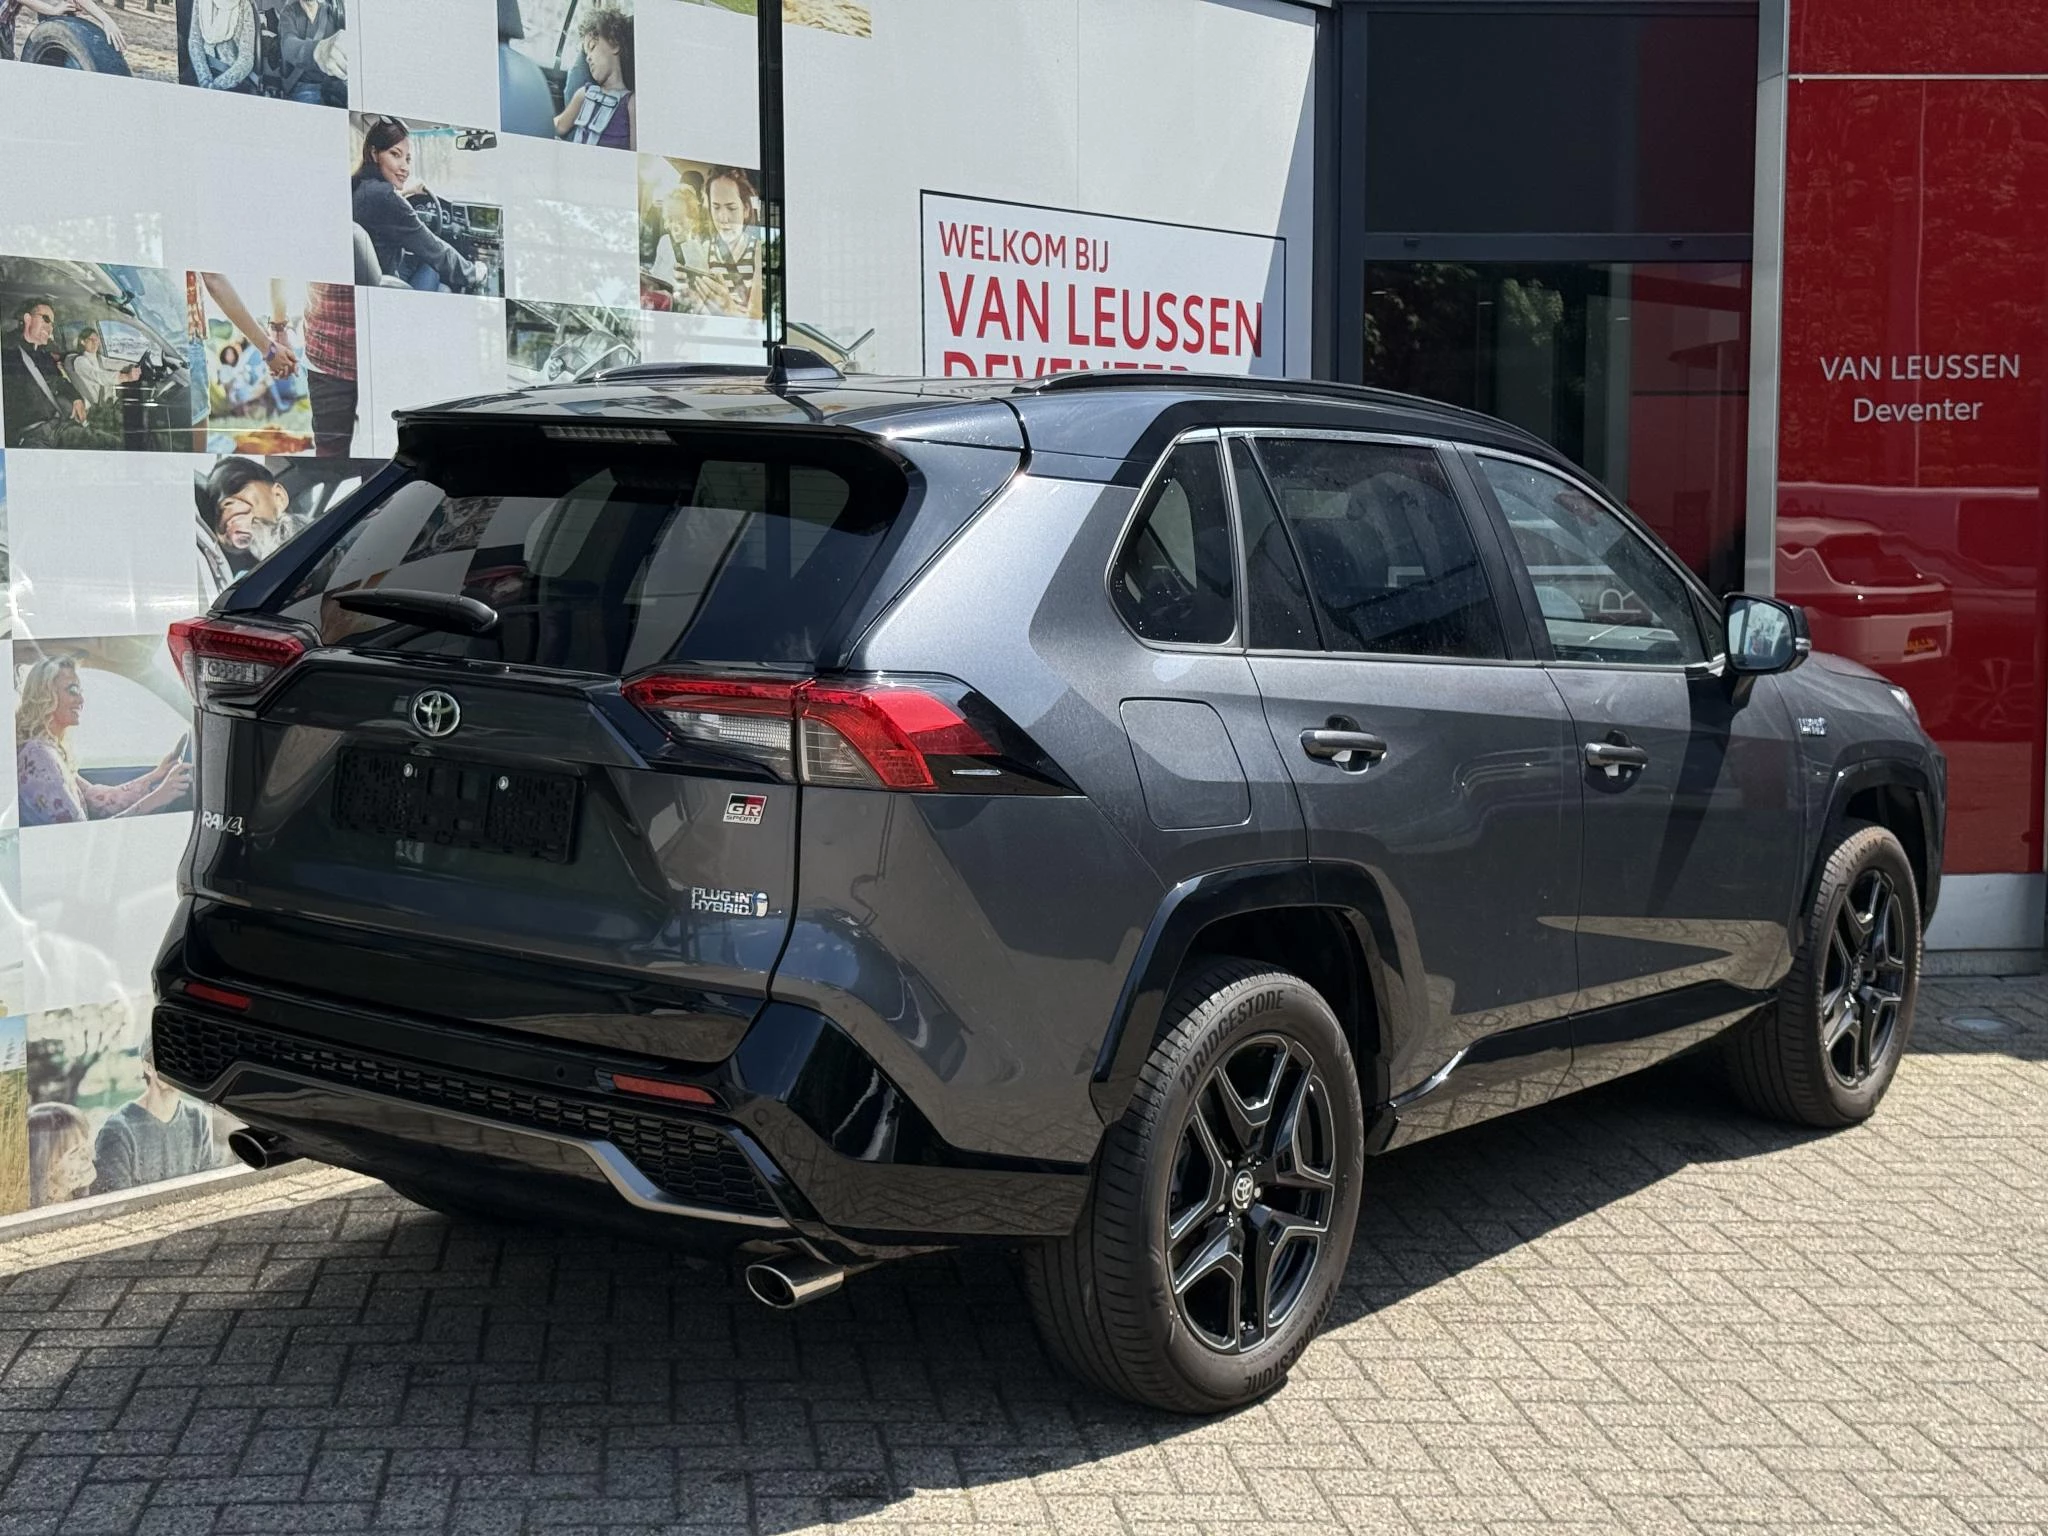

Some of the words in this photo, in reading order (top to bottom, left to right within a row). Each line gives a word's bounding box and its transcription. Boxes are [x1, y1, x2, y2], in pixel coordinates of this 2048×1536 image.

[938, 220, 1066, 269] WELKOM
[1075, 237, 1109, 273] BIJ
[938, 271, 1049, 343] VAN
[1068, 283, 1262, 358] LEUSSEN
[1820, 355, 1881, 381] VAN
[1891, 353, 2021, 380] LEUSSEN
[1853, 398, 1984, 423] Deventer
[725, 814, 759, 823] SPORT
[727, 802, 762, 816] GR
[202, 810, 243, 836] RAV4
[691, 886, 753, 904] PLUG-IN
[691, 899, 752, 916] HYBRID
[1180, 989, 1285, 1095] BRIDGESTONE
